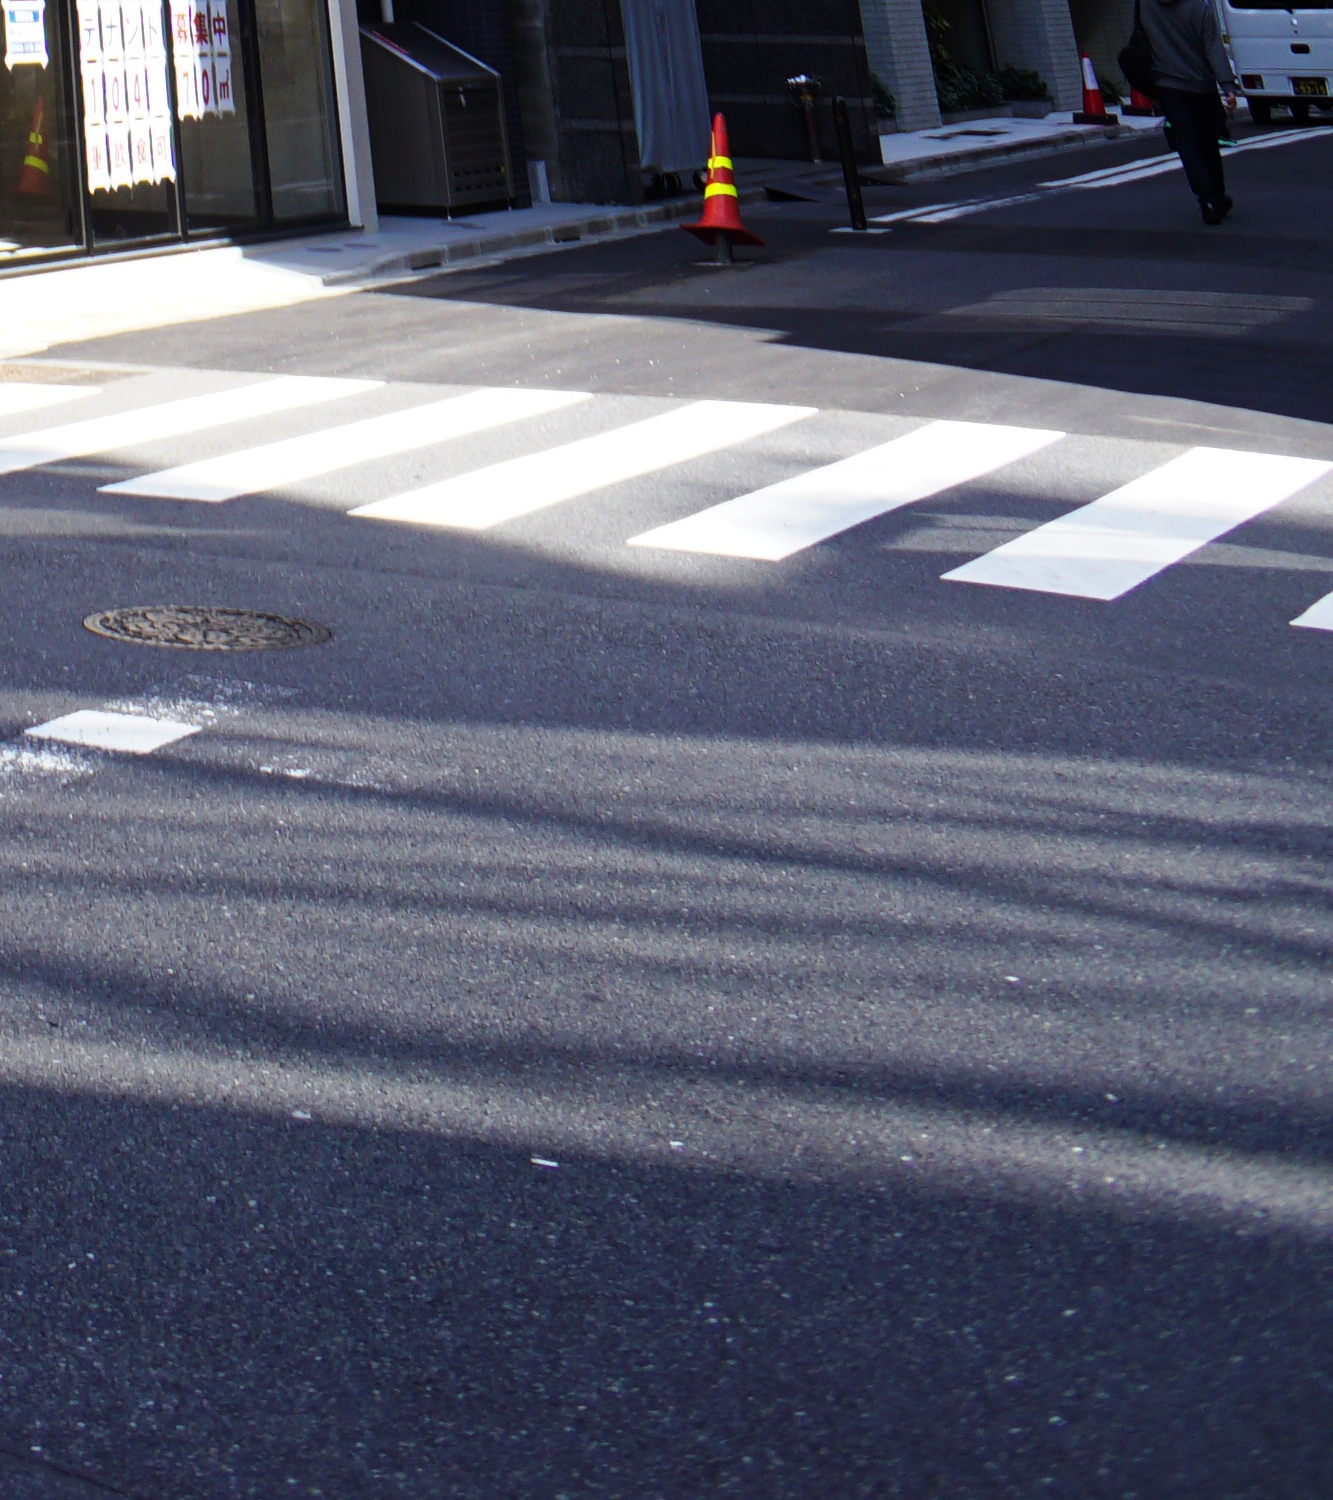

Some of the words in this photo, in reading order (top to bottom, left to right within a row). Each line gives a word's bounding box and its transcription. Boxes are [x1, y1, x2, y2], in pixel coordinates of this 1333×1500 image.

[84, 15, 158, 48] テナント
[173, 11, 226, 46] 募集中
